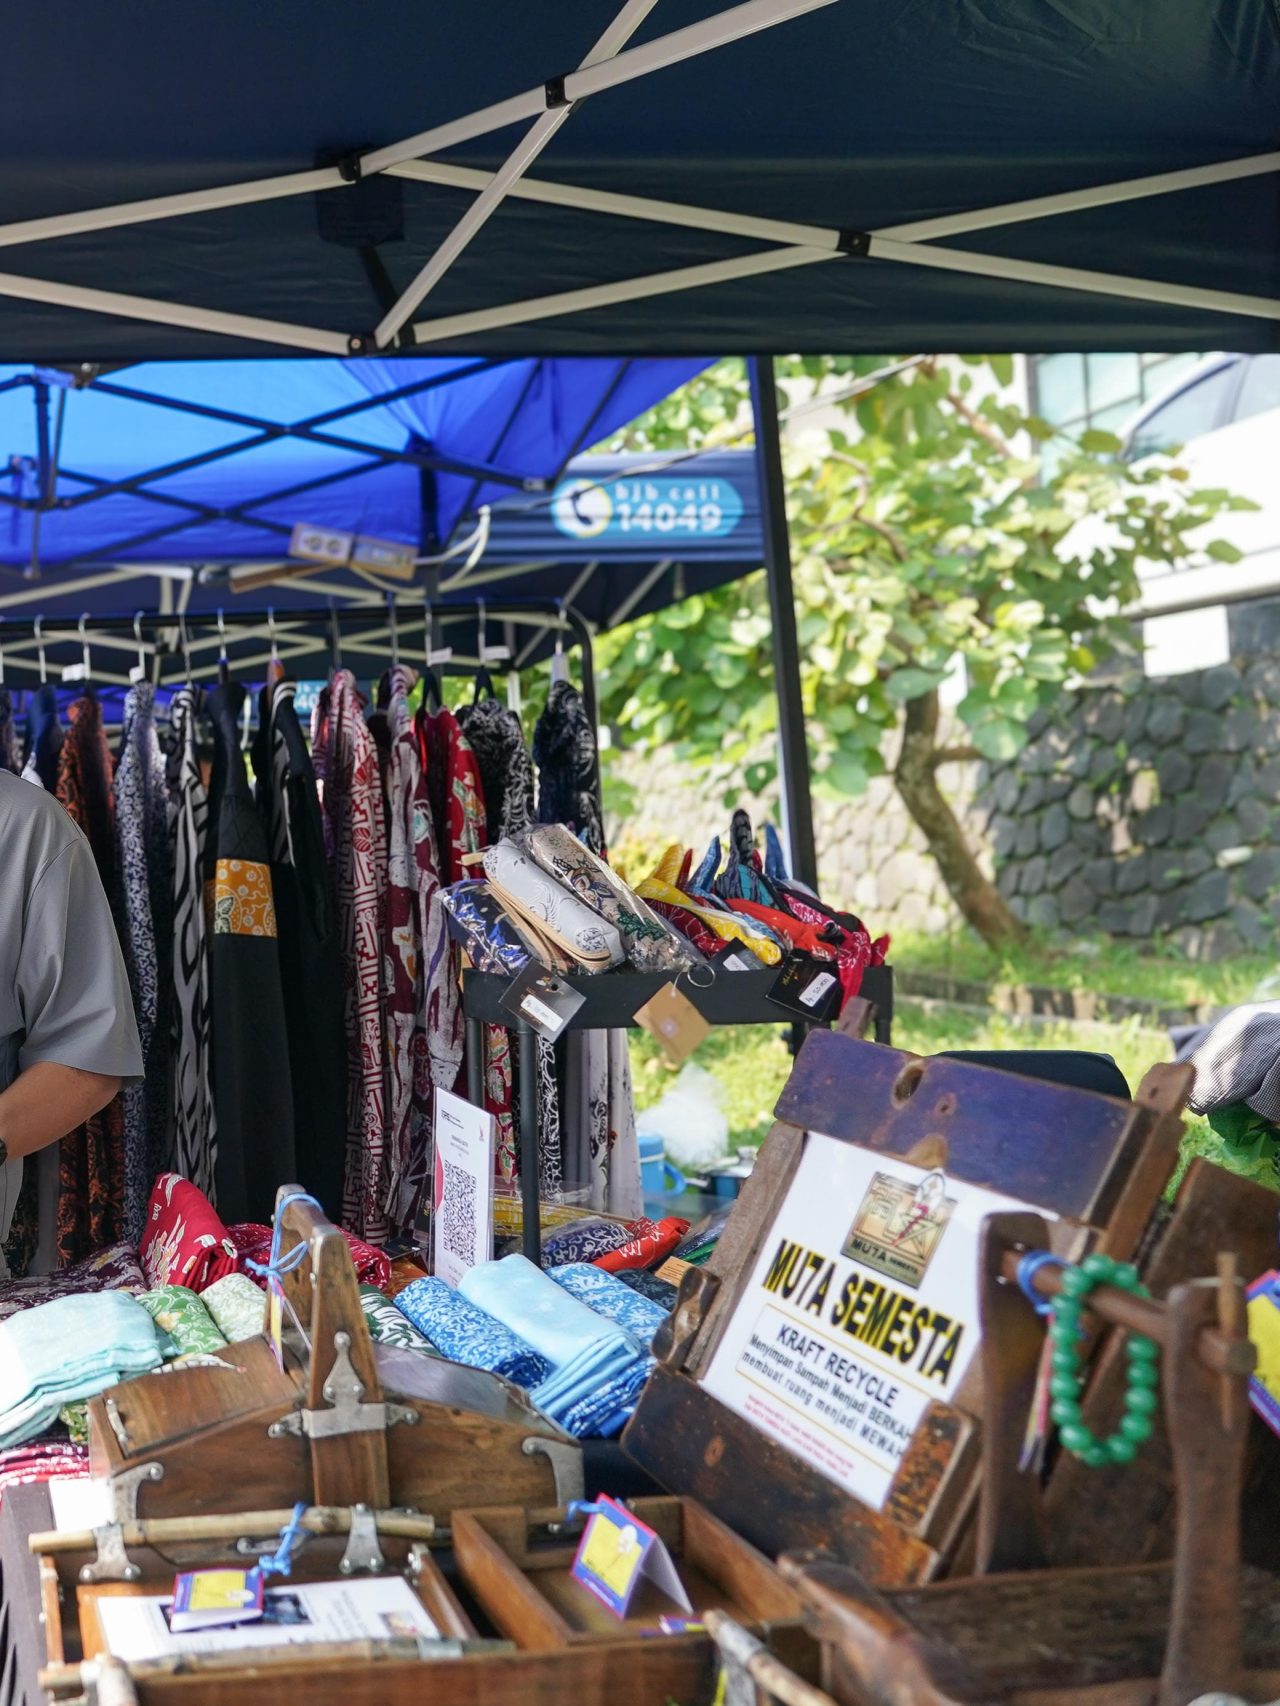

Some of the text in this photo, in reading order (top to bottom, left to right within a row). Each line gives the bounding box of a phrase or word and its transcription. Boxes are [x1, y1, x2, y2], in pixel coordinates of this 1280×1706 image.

[615, 481, 720, 503] bjb call
[615, 502, 722, 532] 14049
[776, 1323, 900, 1409] KRAFT RECYCLE
[830, 1271, 966, 1386] SEMESTA
[741, 1351, 785, 1386] membuat
[784, 1379, 814, 1406] ruang
[814, 1397, 858, 1434] menjadi
[748, 1333, 795, 1370] Menyimpan
[794, 1361, 830, 1393] Sampah
[830, 1382, 869, 1416] Menjadi
